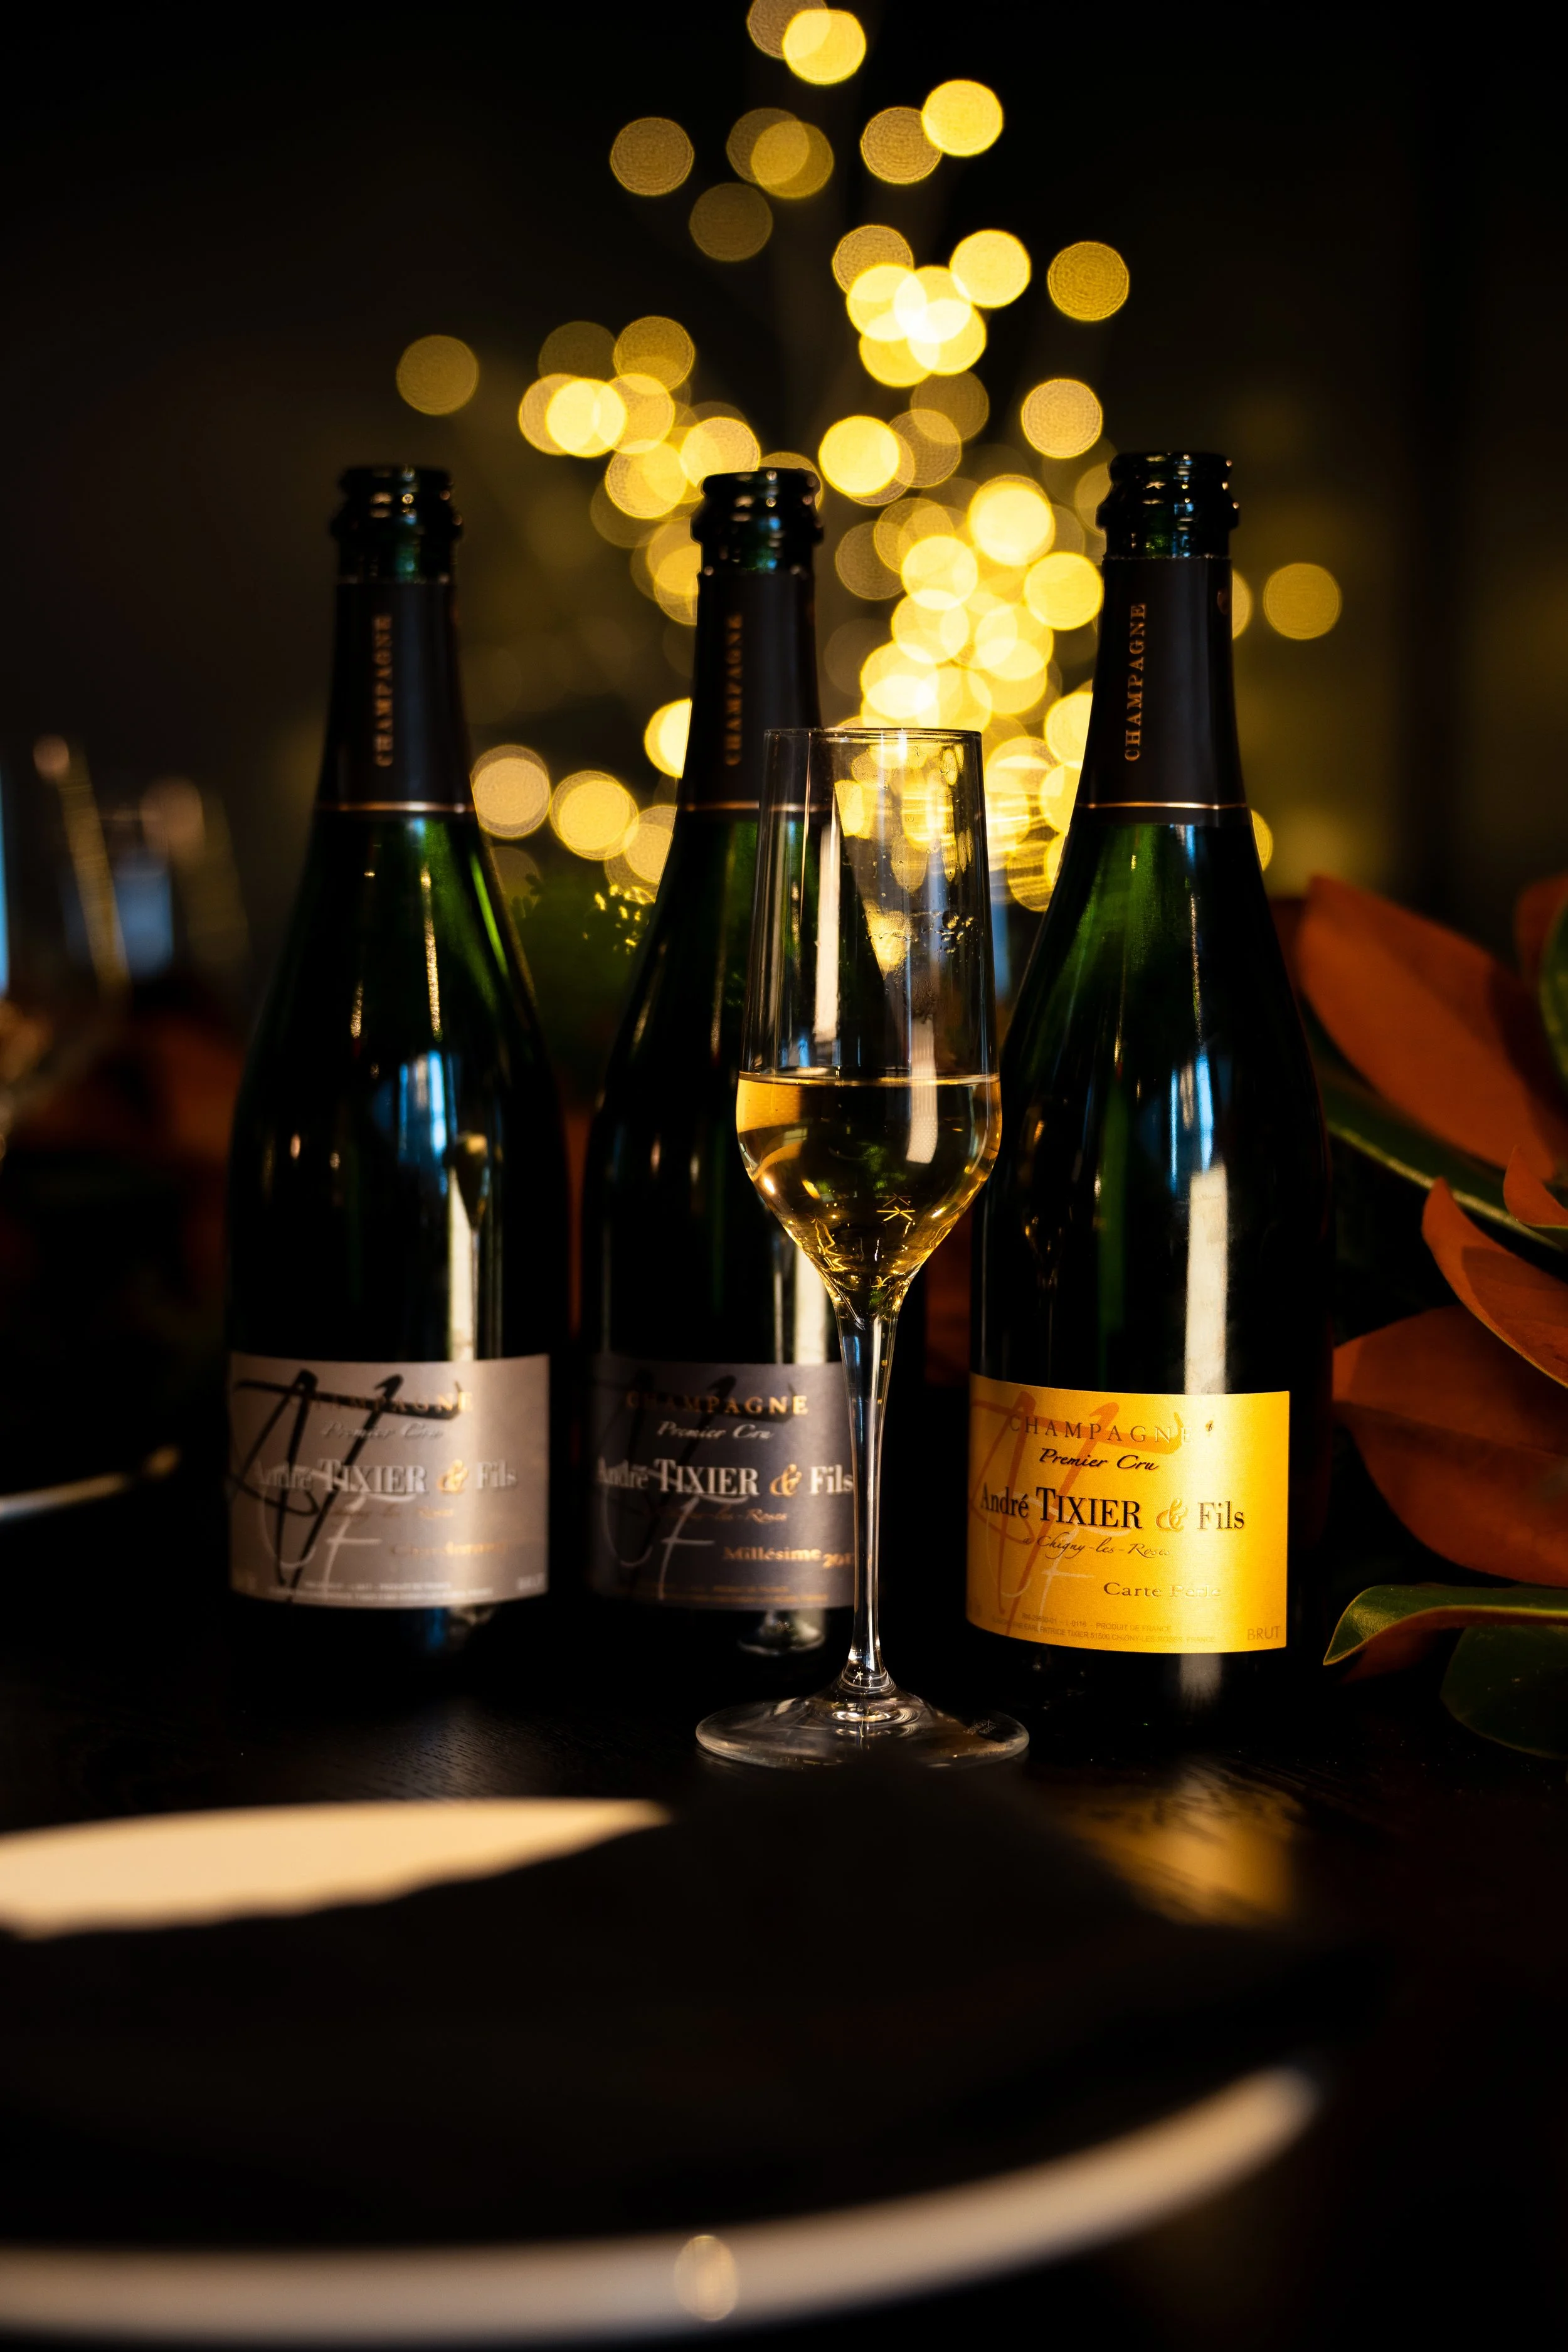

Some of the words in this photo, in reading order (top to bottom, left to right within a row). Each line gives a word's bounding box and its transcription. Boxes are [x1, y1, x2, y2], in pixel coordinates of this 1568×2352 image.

[1125, 603, 1146, 761] CHAMPAGNE
[656, 1421, 726, 1440] Premier
[732, 1424, 775, 1440] Cru
[1009, 1414, 1193, 1444] CHAMPAGNE
[1039, 1447, 1108, 1469] Premier
[1116, 1454, 1159, 1471] Cru
[317, 1458, 428, 1493] TIXIER
[438, 1459, 469, 1494] &
[476, 1459, 518, 1490] Fils
[653, 1458, 760, 1496] TIXIER
[770, 1463, 802, 1498] &
[810, 1465, 854, 1496] Fils
[980, 1483, 1029, 1518] André
[1036, 1486, 1143, 1530] TIXIER
[1156, 1497, 1189, 1532] &
[1197, 1501, 1244, 1530] Fils
[723, 1547, 822, 1562] Millésime
[1103, 1582, 1162, 1597] Carte
[1169, 1584, 1221, 1597] Perle
[1040, 1626, 1066, 1636] PATRICE
[1068, 1629, 1089, 1639] TIXIER
[1090, 1632, 1110, 1641] 51500
[1096, 1621, 1128, 1631] PRODUIT
[1248, 1626, 1281, 1641] BRUT
